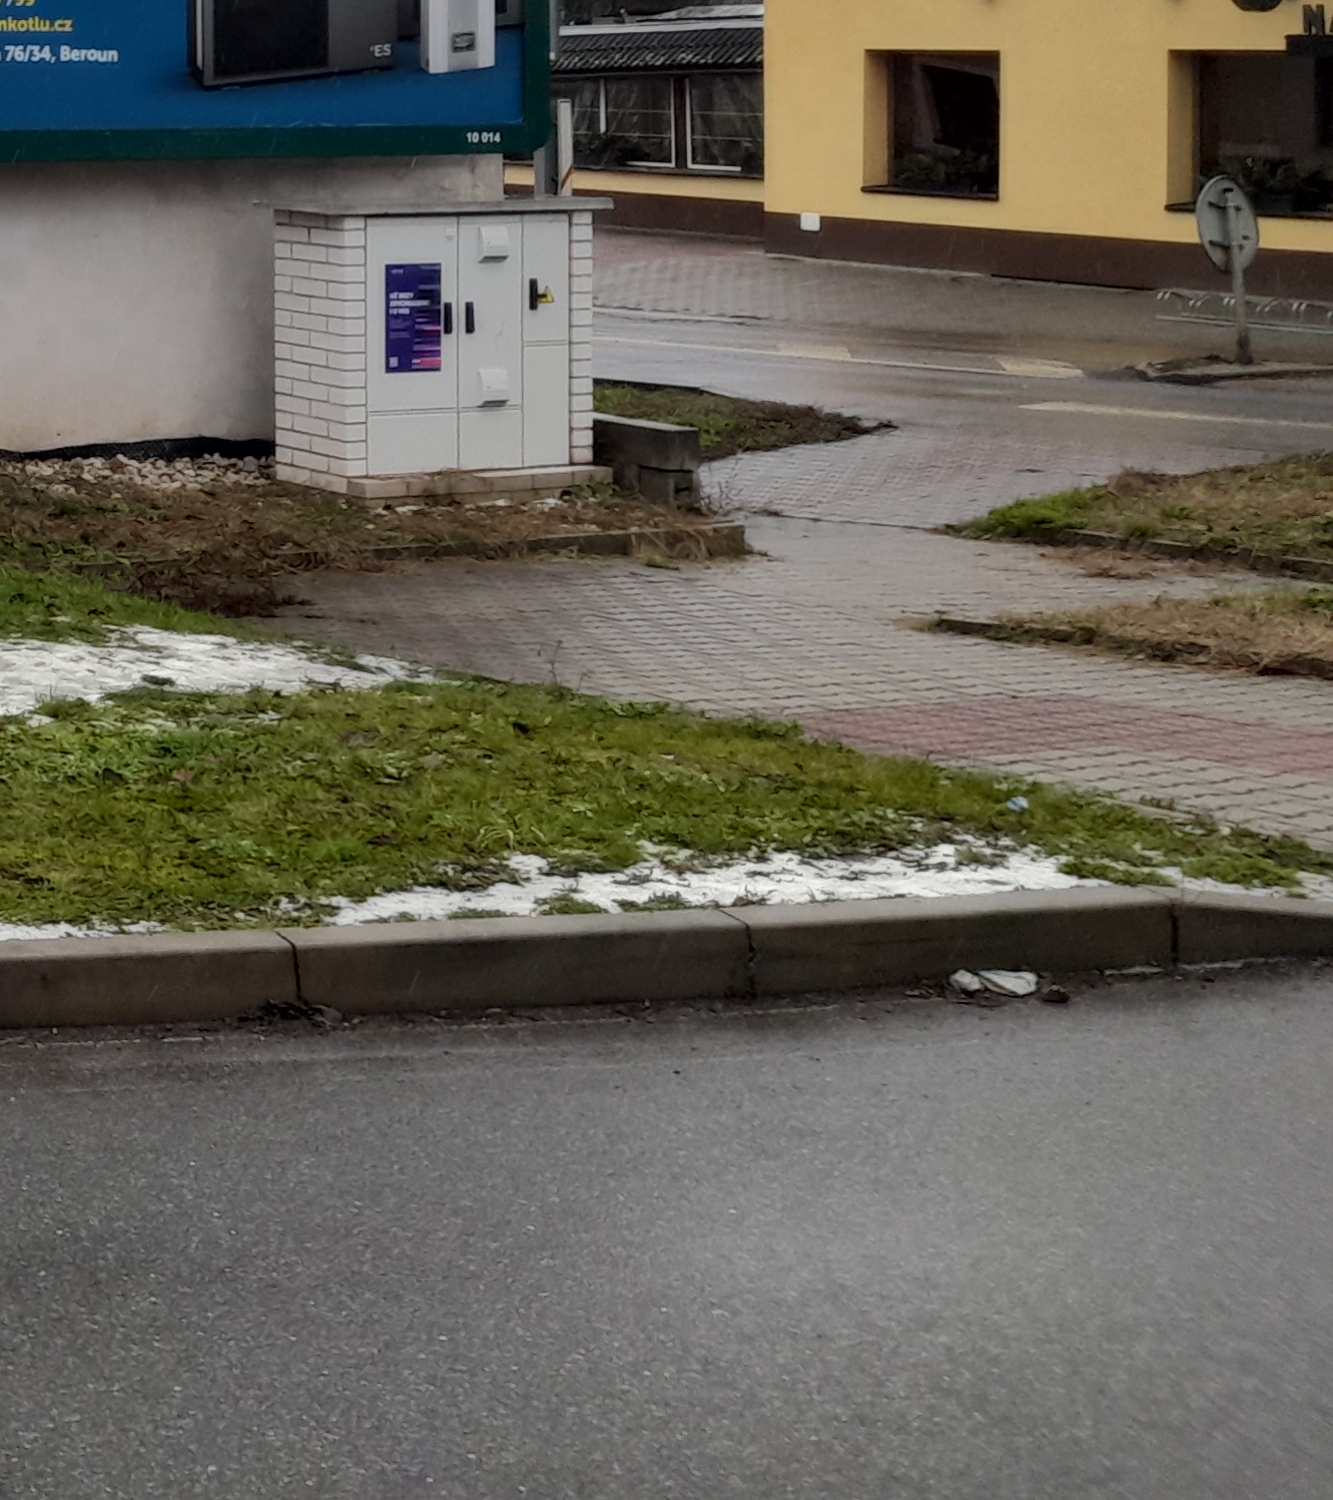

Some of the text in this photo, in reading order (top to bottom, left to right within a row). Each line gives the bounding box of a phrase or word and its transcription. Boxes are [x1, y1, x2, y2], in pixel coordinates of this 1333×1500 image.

[4, 44, 56, 64] 76/34,
[59, 45, 119, 63] Beroun
[466, 131, 501, 144] 10 014
